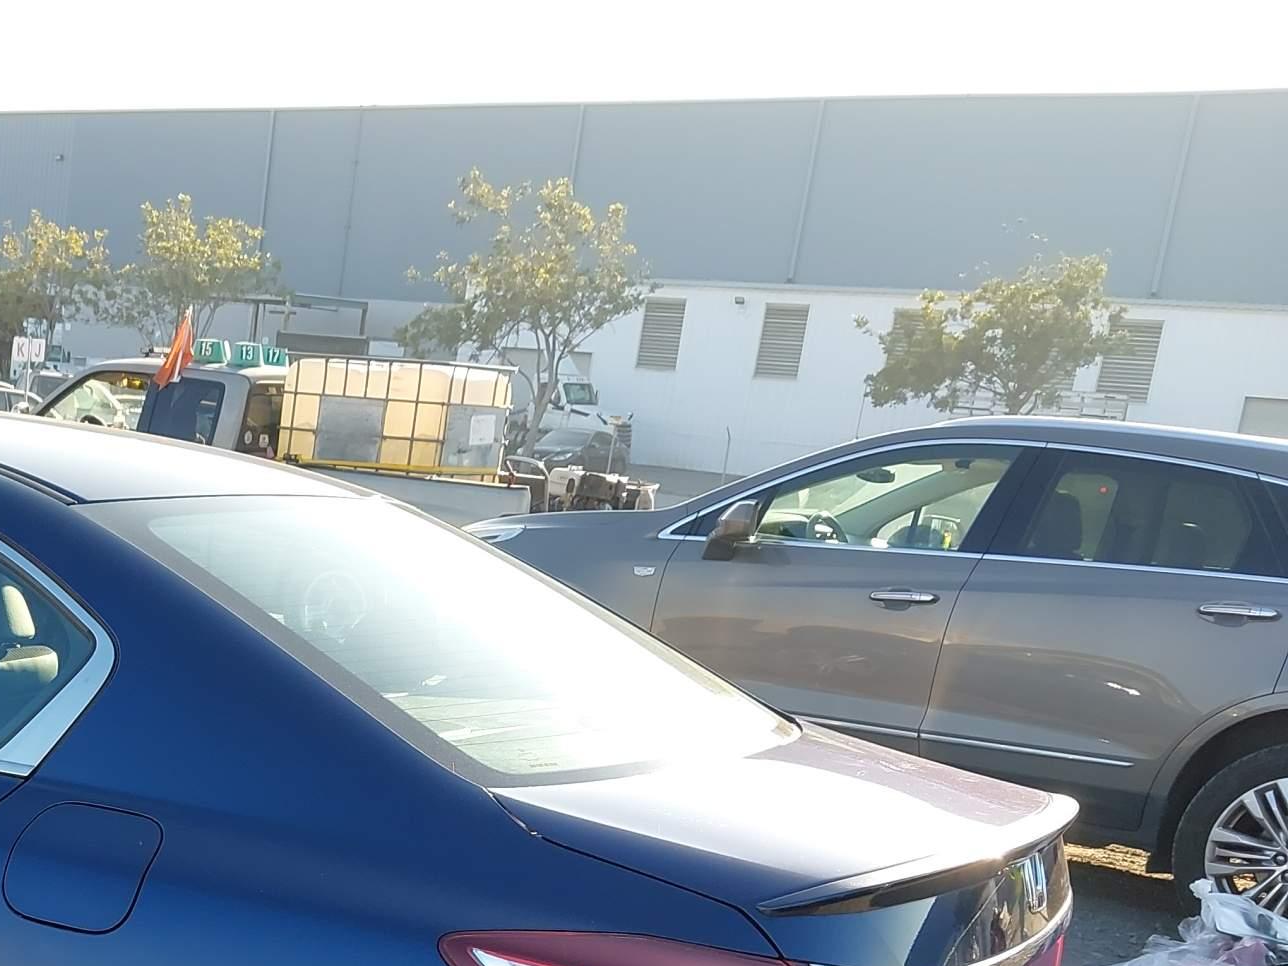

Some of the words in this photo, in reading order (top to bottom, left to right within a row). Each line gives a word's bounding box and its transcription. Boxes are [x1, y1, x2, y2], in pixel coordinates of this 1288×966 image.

[16, 342, 25, 358] K
[34, 343, 41, 358] J
[200, 341, 213, 357] 15
[241, 345, 254, 361] 13
[267, 348, 281, 364] 17
